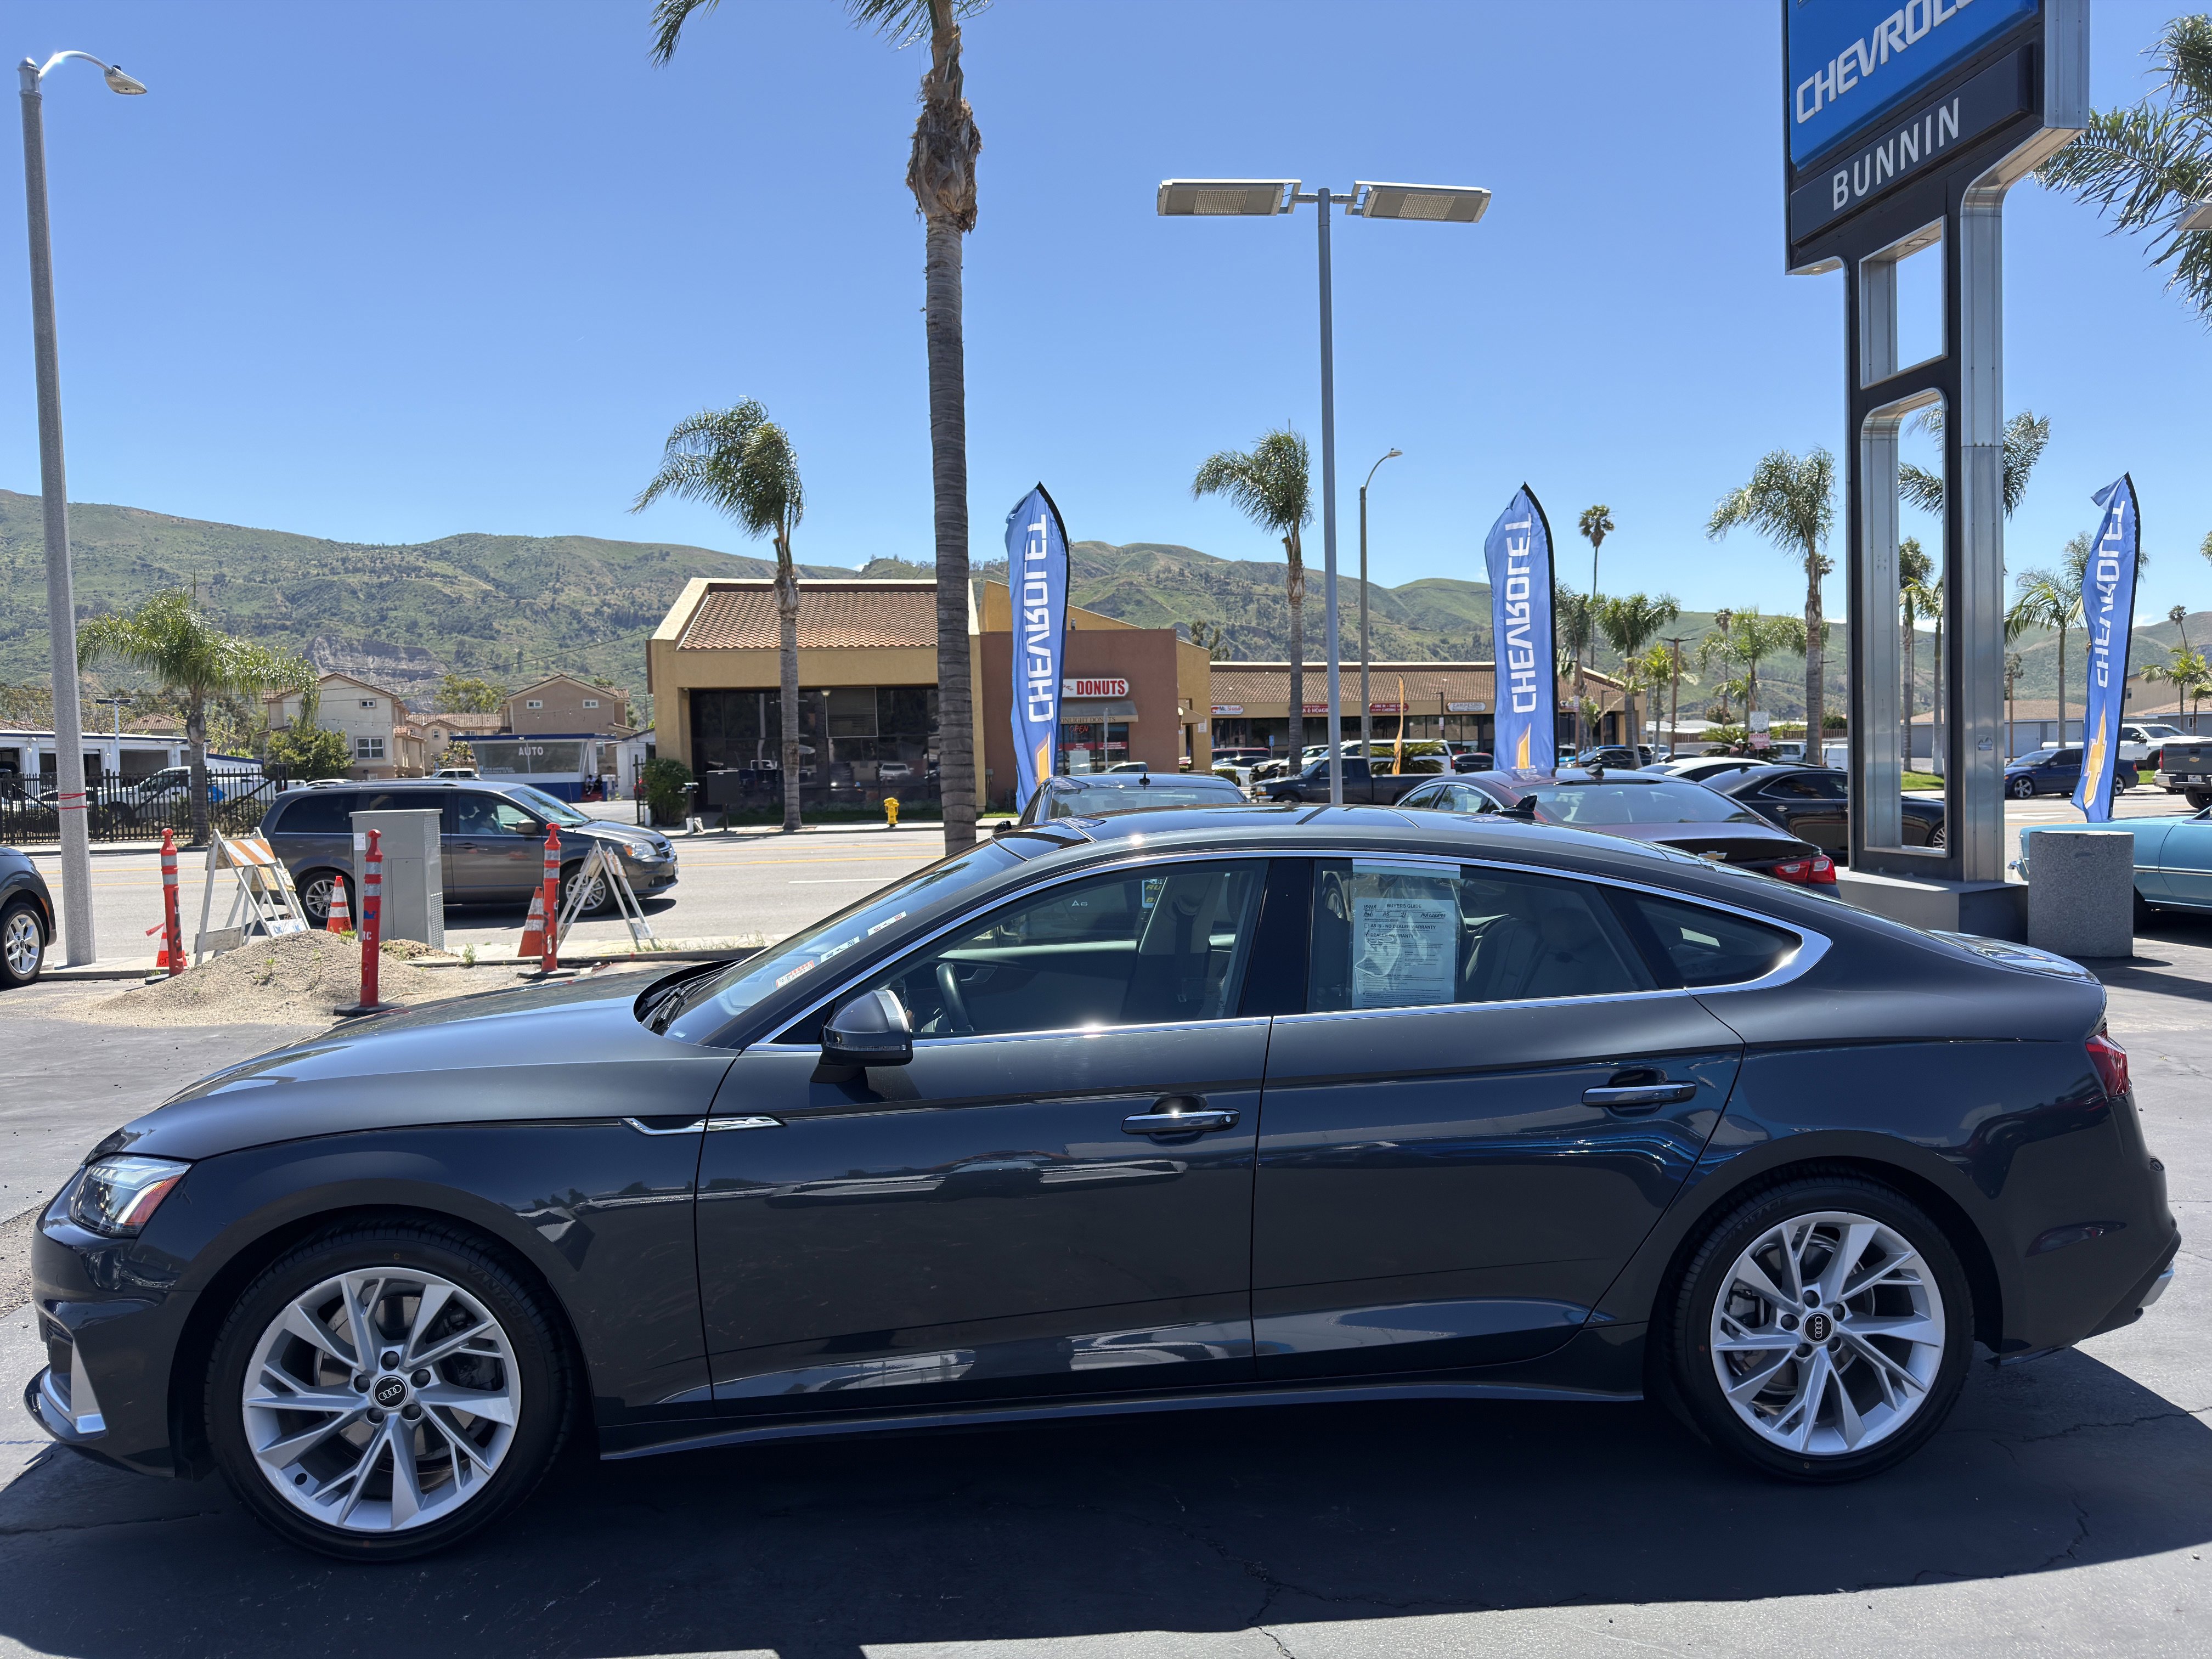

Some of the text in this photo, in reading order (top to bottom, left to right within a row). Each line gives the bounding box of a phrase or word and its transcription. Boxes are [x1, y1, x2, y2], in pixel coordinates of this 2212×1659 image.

[1796, 0, 1975, 124] CHEVROL
[1832, 97, 1960, 212] BUNNIN
[1076, 680, 1125, 695] DONUTS
[1069, 724, 1089, 732] OPEN
[518, 747, 544, 756] AUTO
